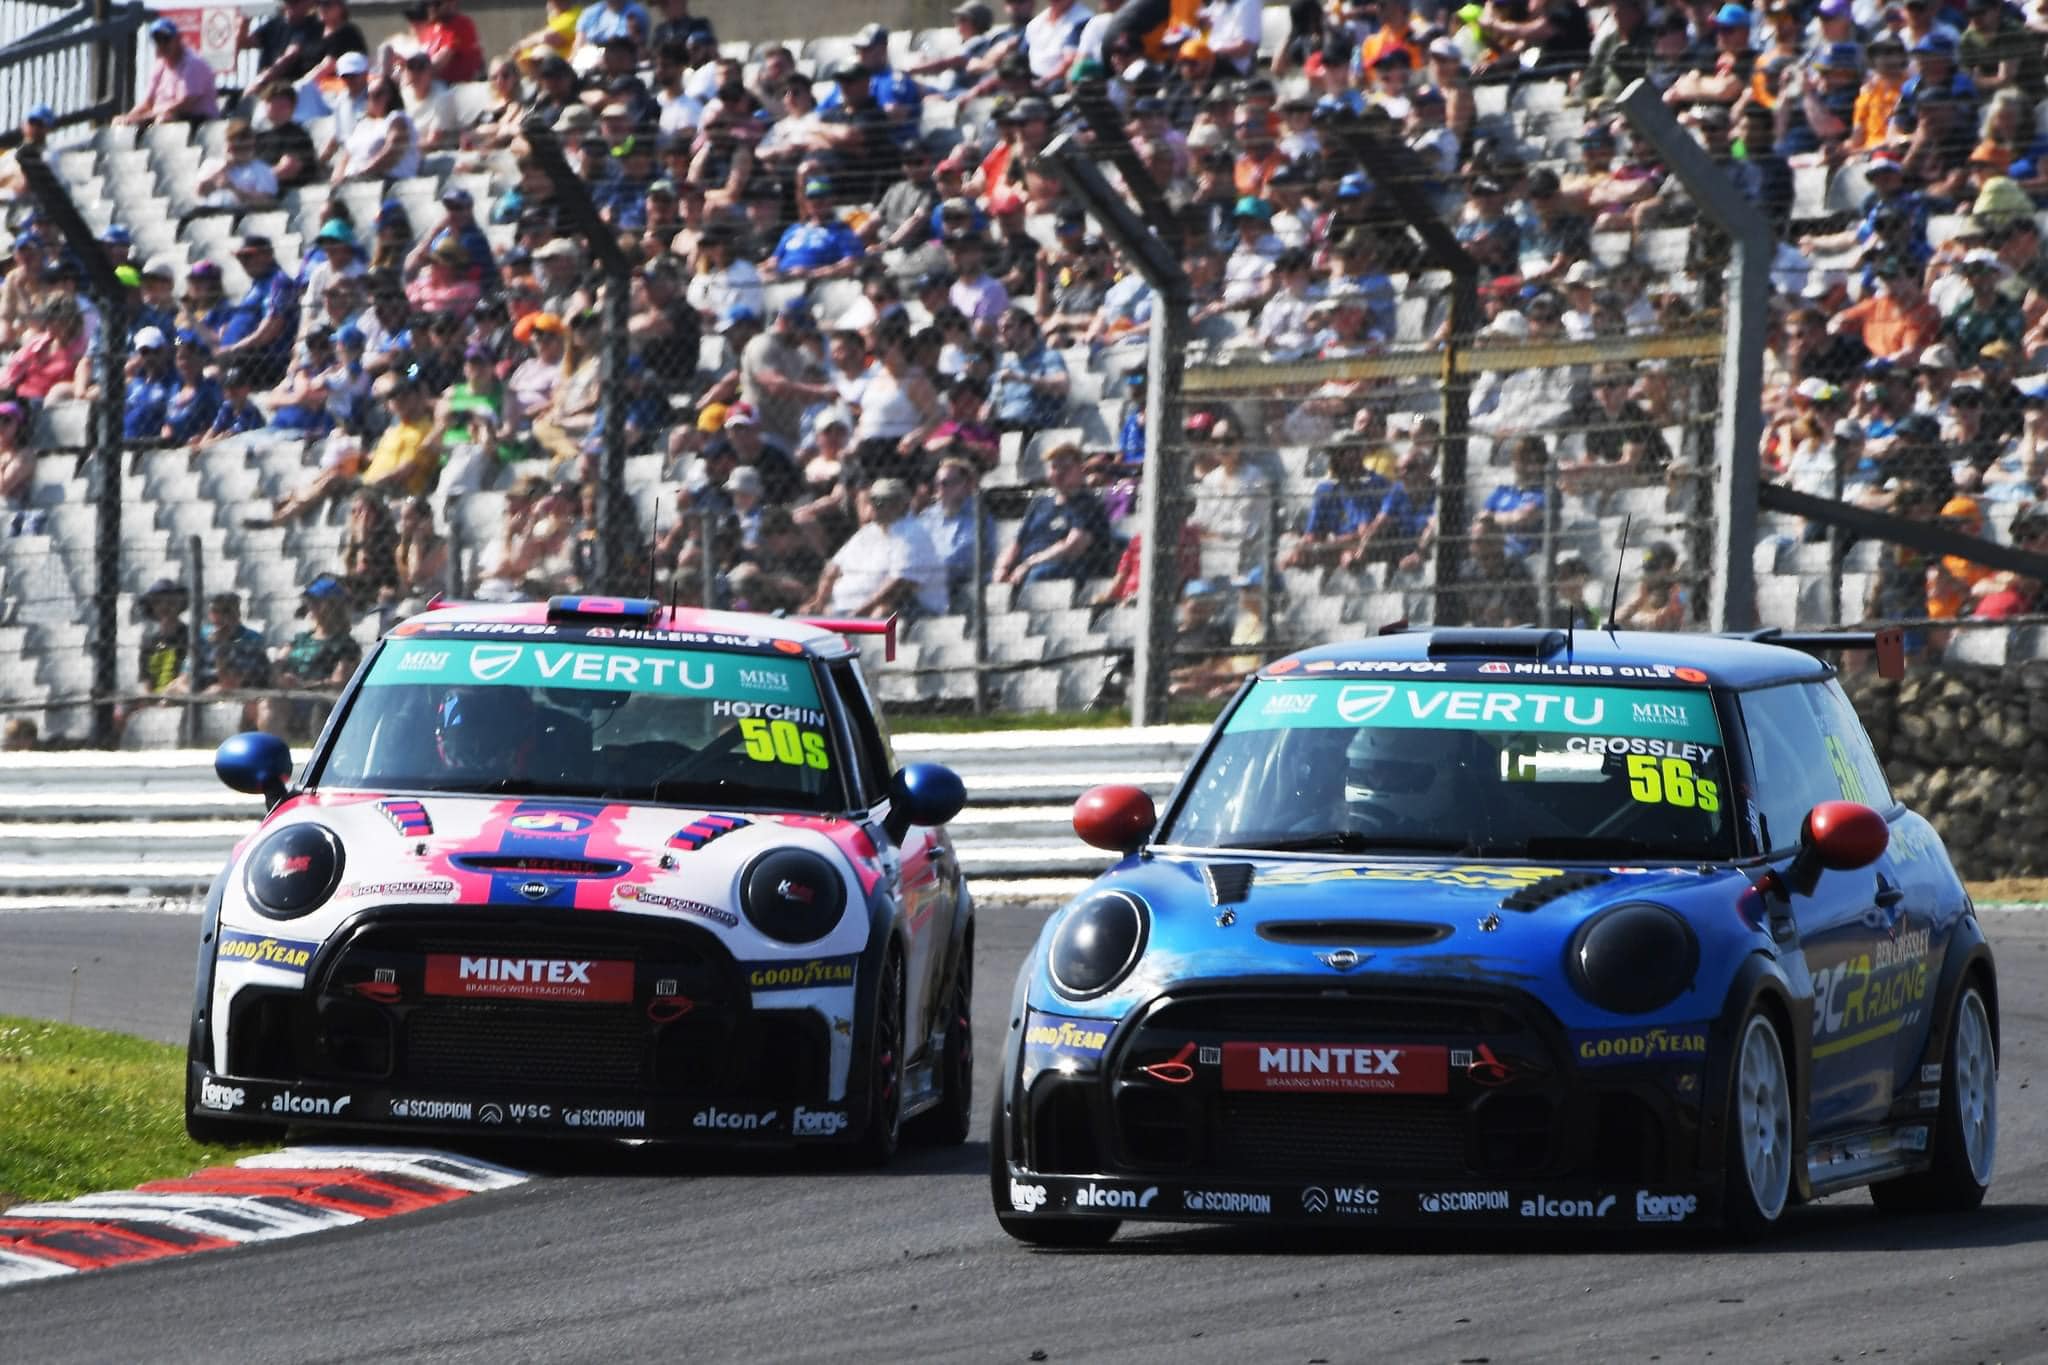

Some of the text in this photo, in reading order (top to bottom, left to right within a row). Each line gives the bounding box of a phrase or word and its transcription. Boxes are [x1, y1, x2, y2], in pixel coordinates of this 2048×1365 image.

[618, 627, 760, 647] MILLERS OILS
[534, 650, 714, 689] VERTU
[738, 669, 788, 685] MINI
[1514, 663, 1672, 679] MILLERS OILS
[713, 701, 826, 726] HOTCHIN
[1407, 690, 1604, 726] VERTU
[1632, 703, 1686, 719] MINI
[1633, 716, 1689, 727] CHALLENGE
[738, 717, 829, 770] 50s
[1566, 737, 1714, 764] CROSSLEY
[1626, 754, 1719, 813] 56s
[219, 939, 310, 967] GOODYEAR
[459, 956, 591, 983] MINTEX
[752, 961, 852, 985] GOODYEAR
[466, 983, 585, 996] BRAKING WITH TRADITION
[1580, 1029, 1705, 1058] GOODYEAR
[1259, 1047, 1400, 1074] MINTEX
[1267, 1078, 1395, 1088] BRAKING WITH TRADITION
[272, 1091, 330, 1114] alcon
[410, 1100, 471, 1120] SCORPION
[510, 1103, 551, 1118] WSC
[582, 1109, 645, 1128] SCORPION
[693, 1107, 757, 1129] alcon
[1076, 1183, 1136, 1207] alcon
[1205, 1192, 1271, 1213] SCORPION
[1334, 1188, 1379, 1204] WSC
[1441, 1191, 1509, 1211] SCORPION
[1520, 1195, 1593, 1217] alcon
[1636, 1190, 1696, 1221] forge
[1336, 1205, 1379, 1215] FINANCE
